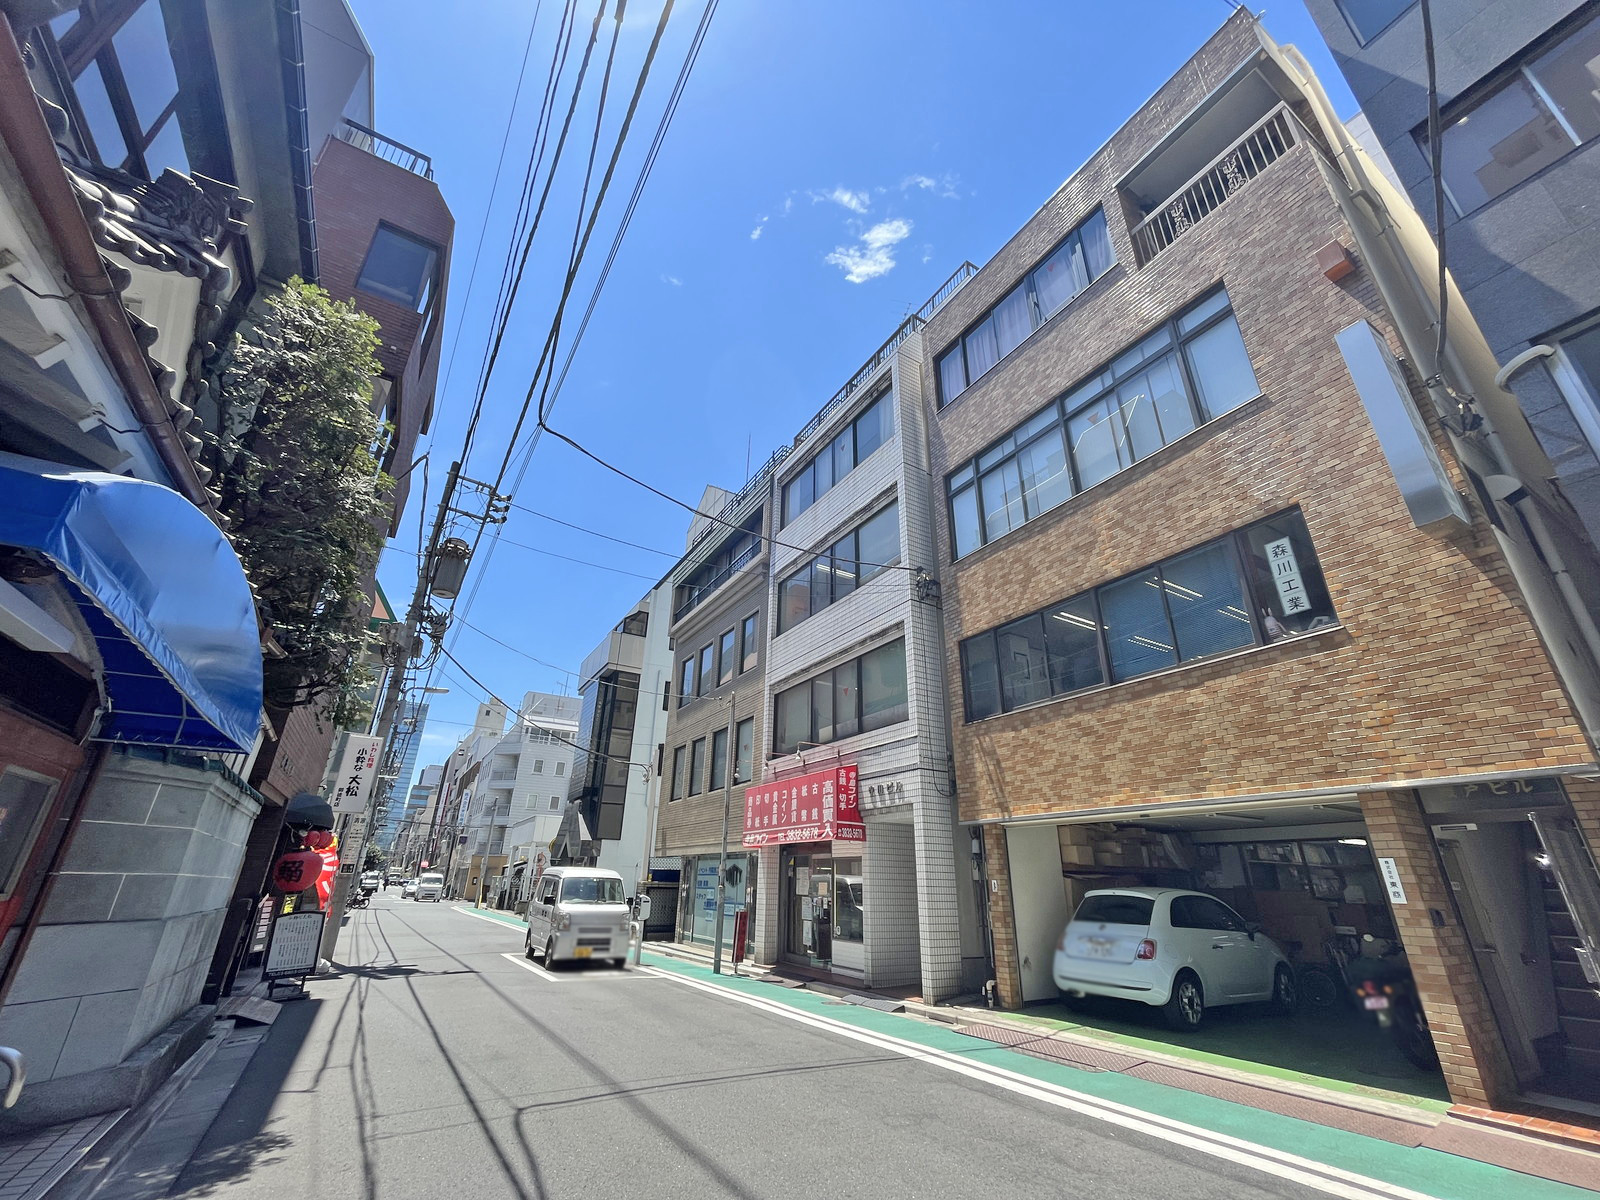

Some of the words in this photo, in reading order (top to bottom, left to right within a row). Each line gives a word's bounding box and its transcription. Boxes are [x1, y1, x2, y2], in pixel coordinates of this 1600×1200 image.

[1271, 543, 1304, 611] 森川工業
[366, 742, 379, 769] いわし料理
[345, 774, 363, 797] 大松
[821, 779, 834, 839] 高価買入
